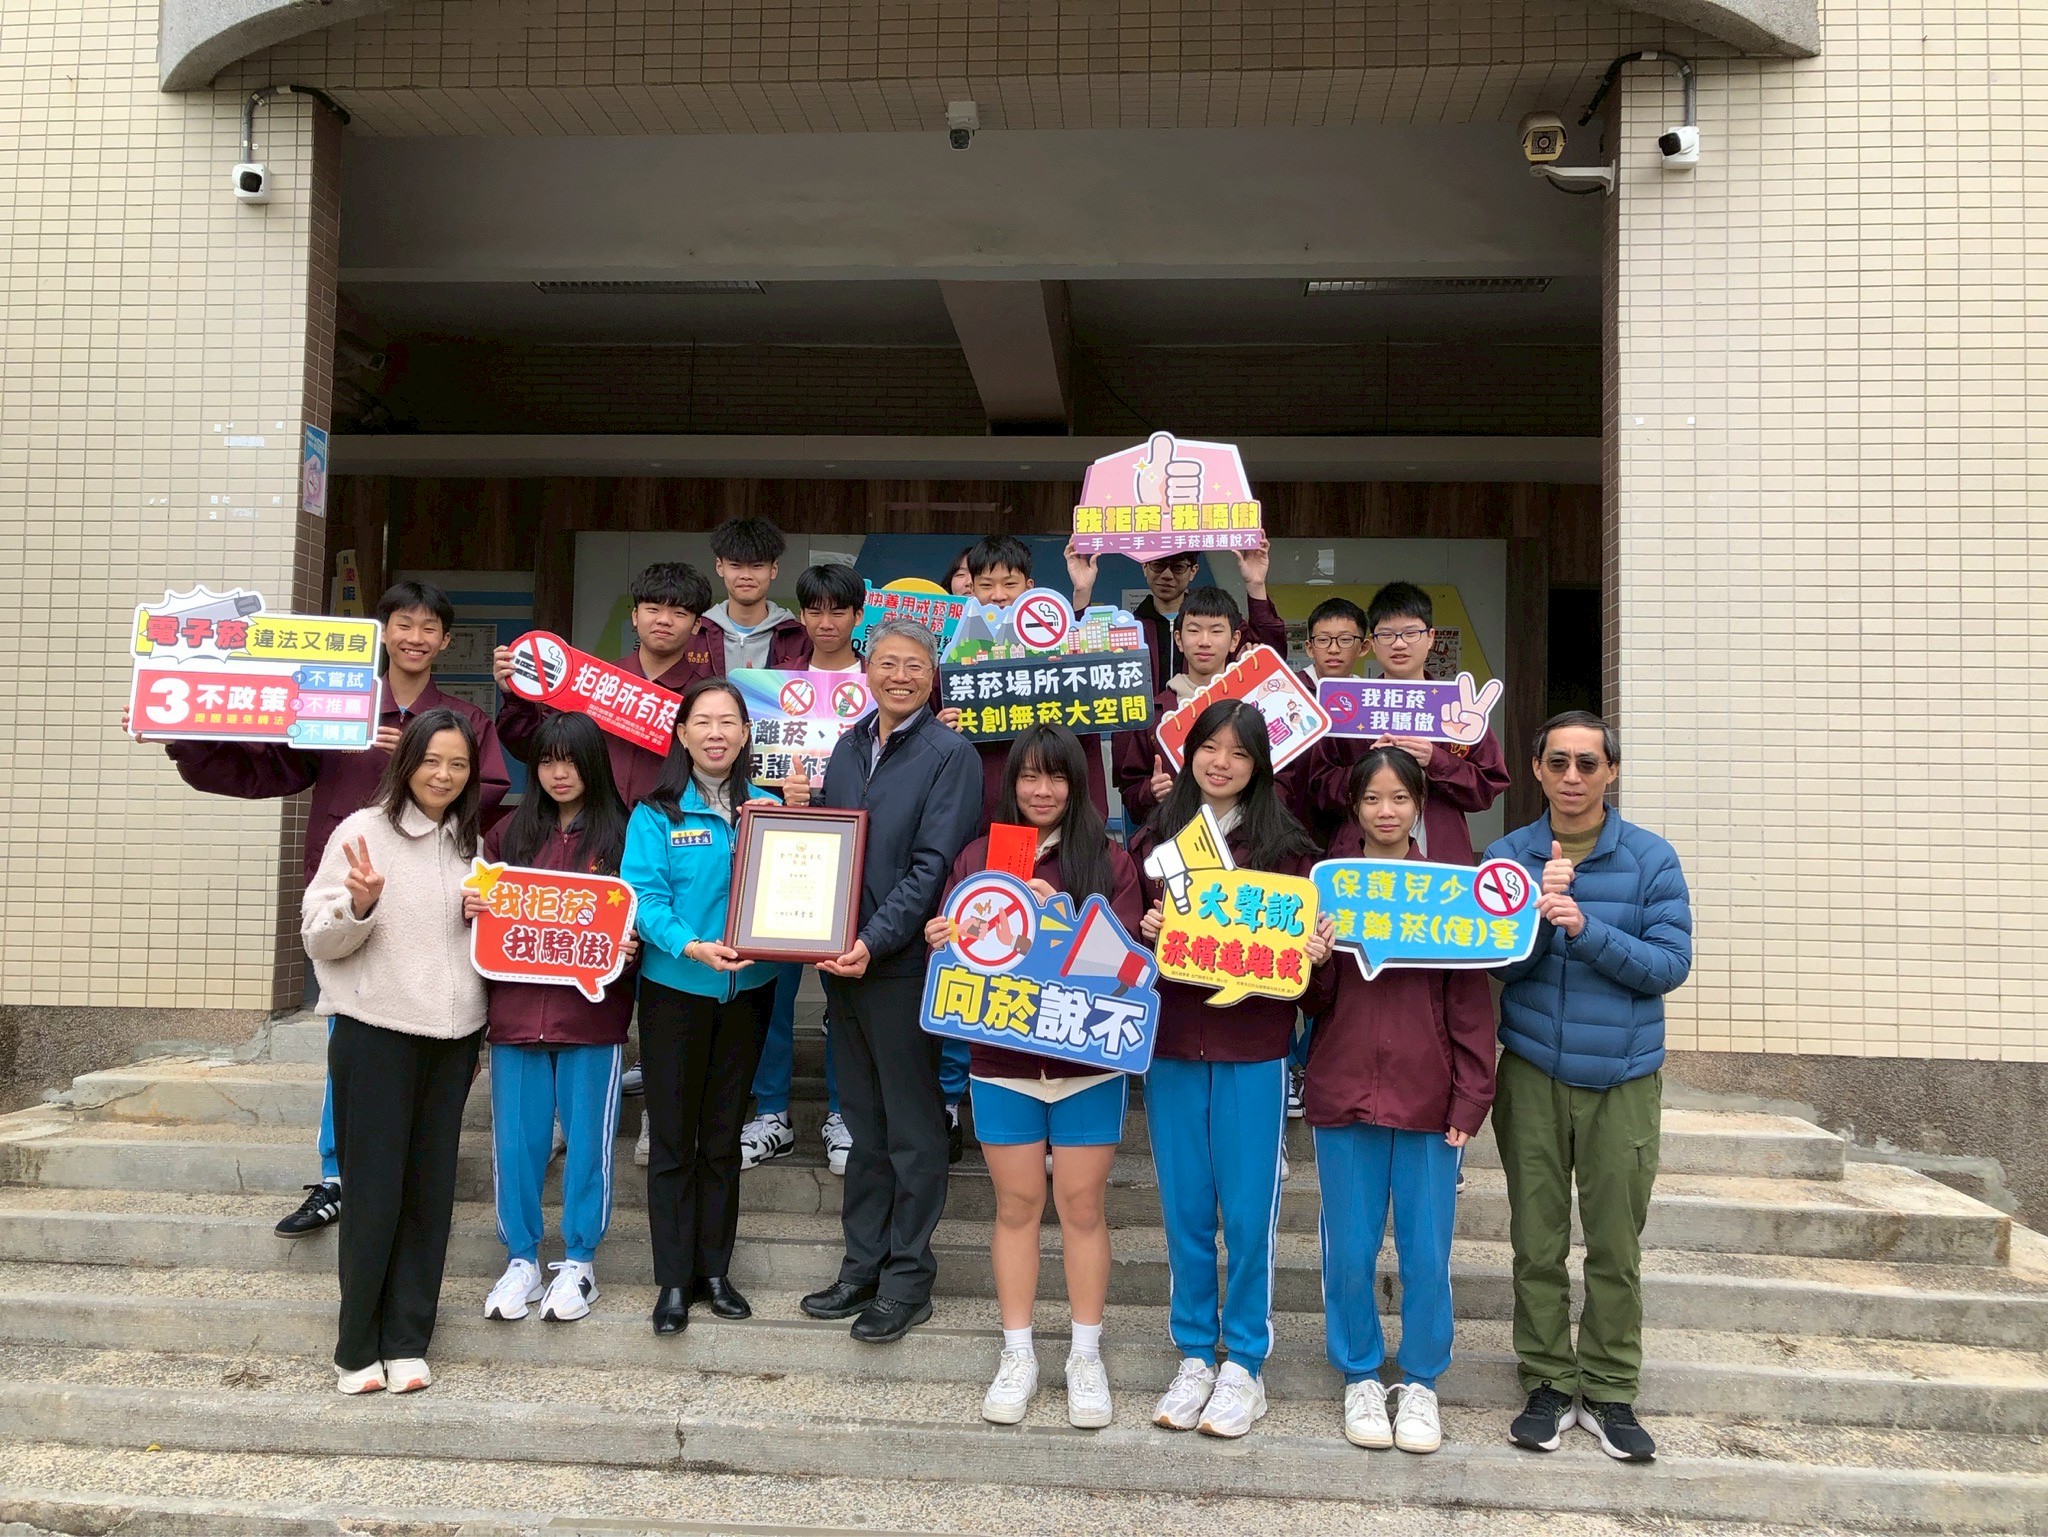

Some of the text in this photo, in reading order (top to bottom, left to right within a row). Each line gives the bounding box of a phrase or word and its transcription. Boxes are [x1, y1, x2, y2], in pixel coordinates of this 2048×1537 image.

[1078, 534, 1257, 551] 一手、二手、三手菸通通說不
[146, 615, 249, 649] 電子菸
[253, 629, 367, 653] 違法又傷身
[308, 670, 364, 689] 不嘗試
[949, 660, 1145, 702] 禁菸場所不吸菸
[306, 696, 362, 715] 不推薦
[571, 663, 681, 734] 拒絕所有菸
[957, 694, 1148, 735] 共創無菸大空間
[1361, 687, 1427, 710] 我拒菸
[303, 724, 360, 742] 不購買
[1369, 710, 1436, 732] 我驕傲
[488, 883, 597, 924] 我拒菸
[1332, 868, 1469, 905] 保護兒少
[1198, 883, 1305, 937] 大聲說
[503, 925, 613, 969] 我驕傲
[932, 966, 1145, 1054] 向菸說不
